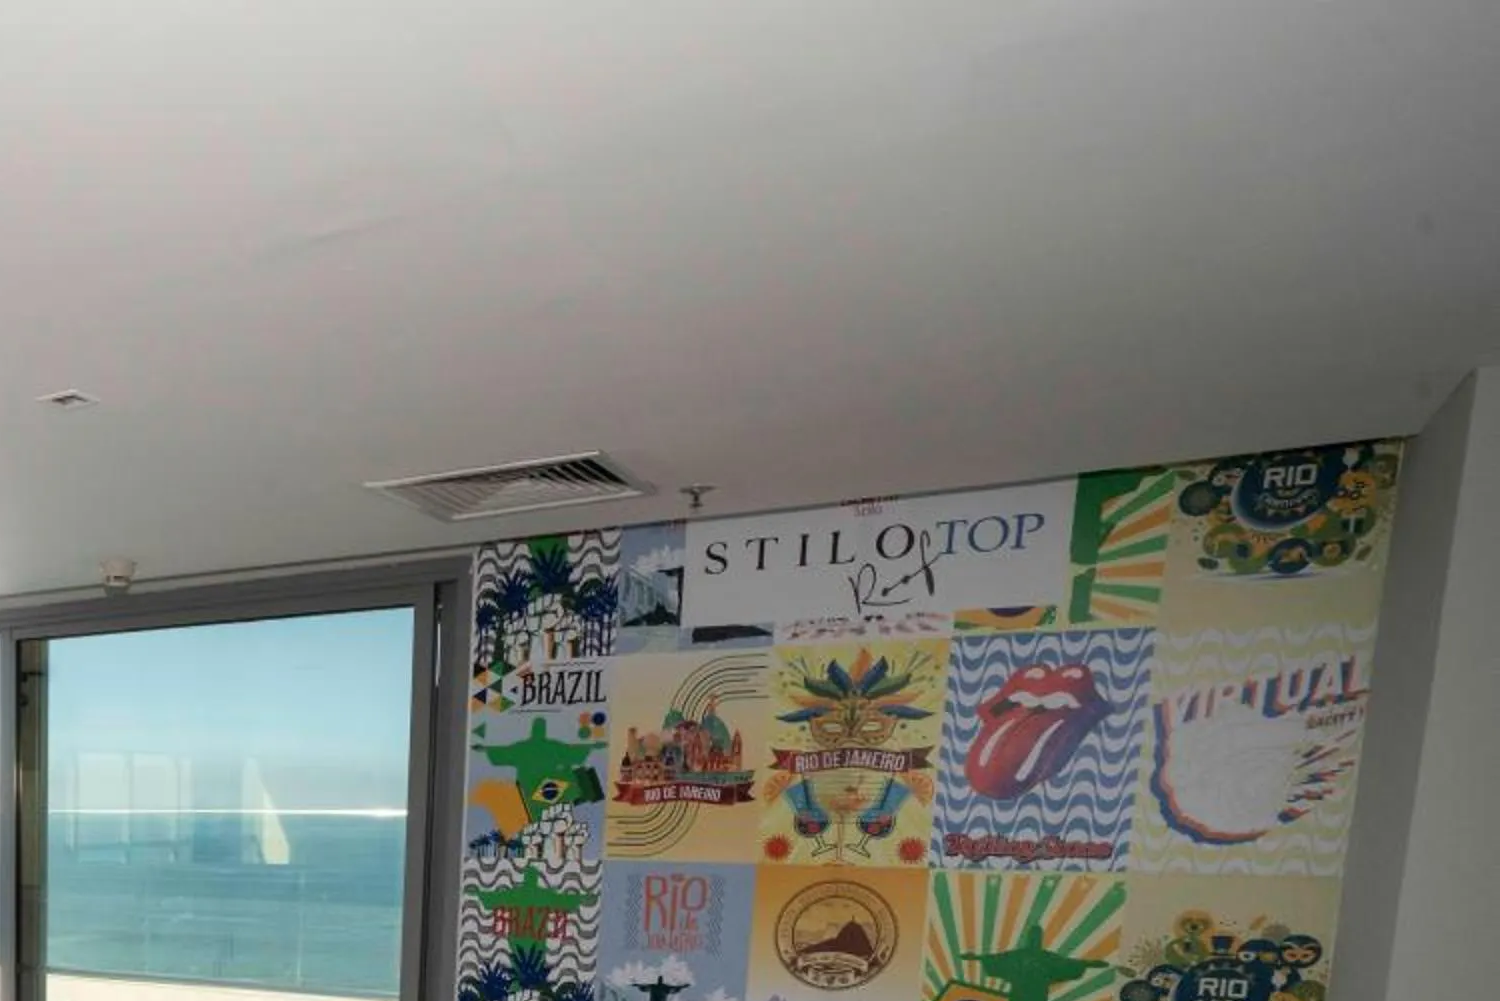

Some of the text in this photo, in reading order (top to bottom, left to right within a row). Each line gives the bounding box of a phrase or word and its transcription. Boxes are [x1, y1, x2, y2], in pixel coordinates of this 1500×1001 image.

[1263, 463, 1318, 490] RIO
[703, 522, 916, 577] STILO
[937, 512, 1046, 557] TOP
[520, 668, 608, 706] BRAZIL
[795, 749, 906, 772] RIO DE JANEIRO
[1197, 977, 1249, 999] RIO
